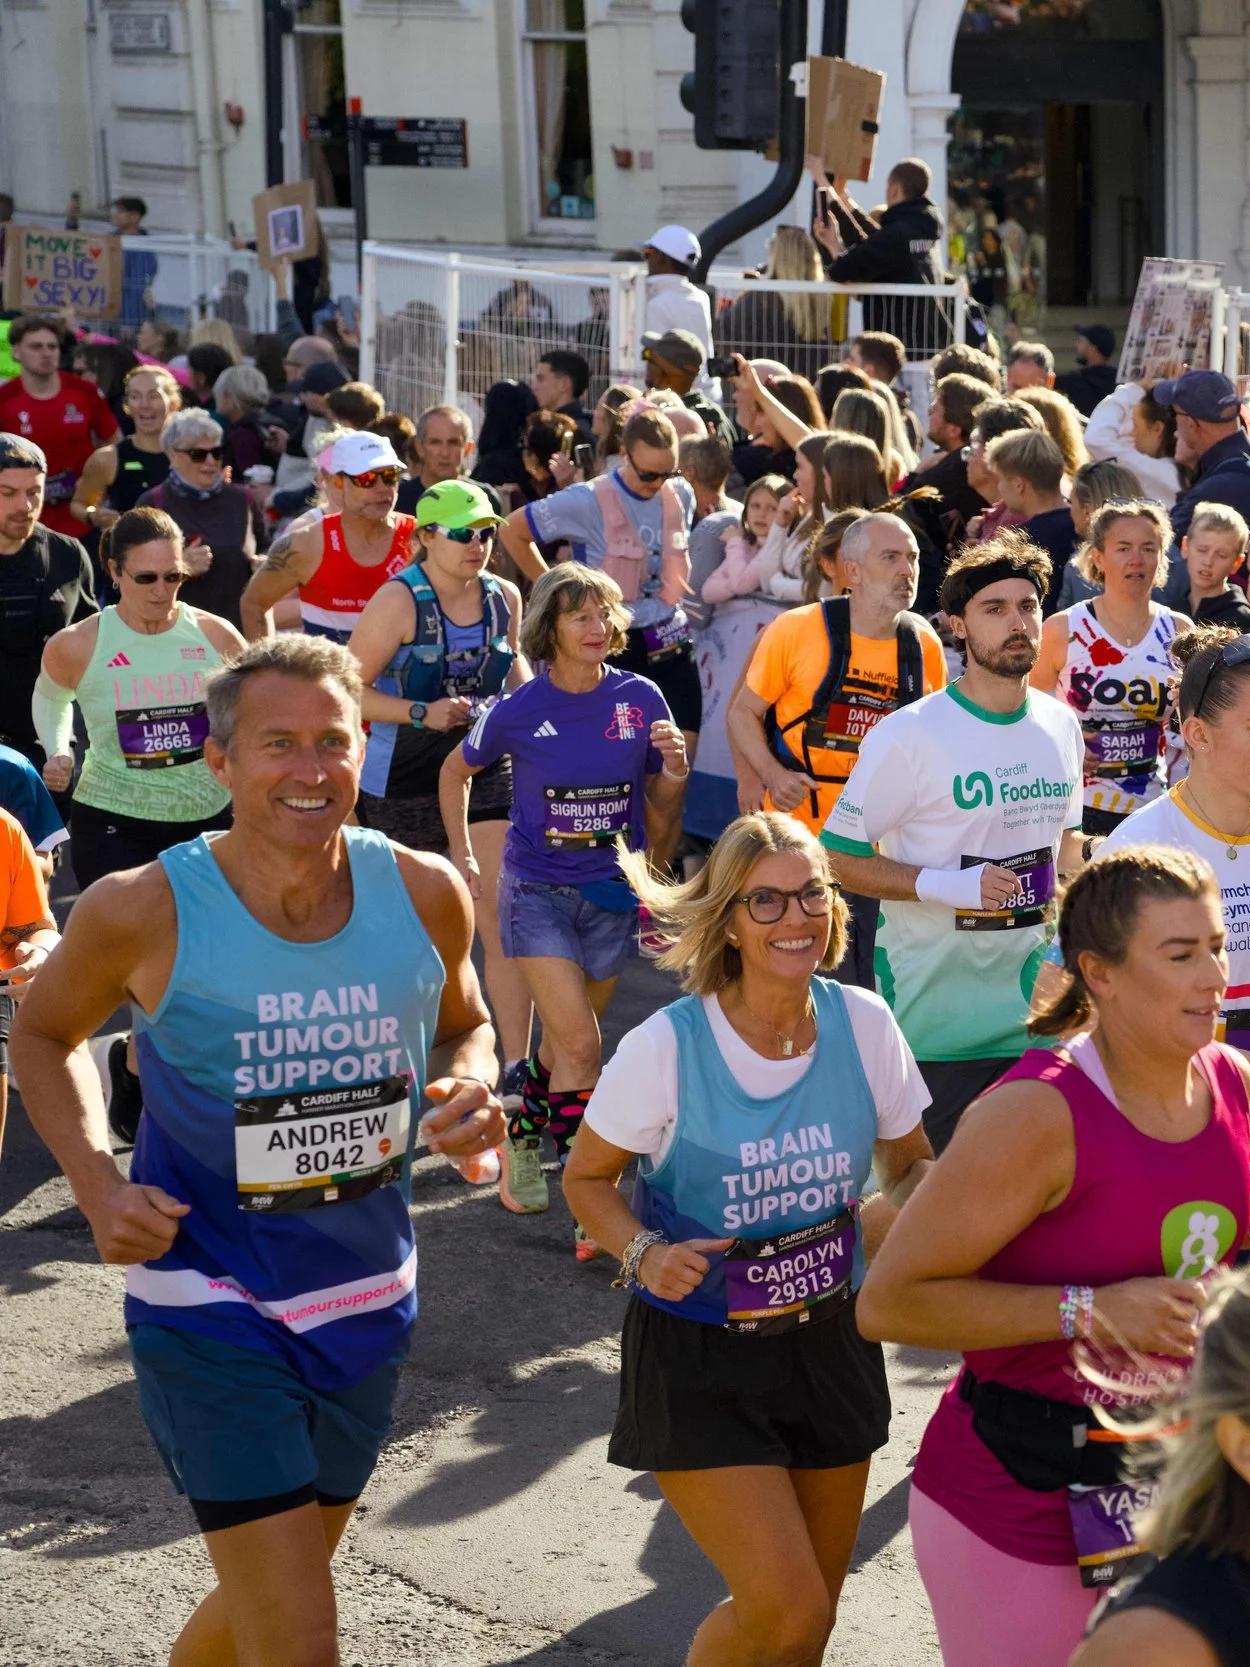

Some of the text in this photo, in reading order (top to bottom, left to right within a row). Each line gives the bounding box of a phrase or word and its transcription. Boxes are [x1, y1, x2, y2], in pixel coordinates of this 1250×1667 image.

[25, 232, 86, 257] MOVE
[26, 253, 97, 282] IT BIG
[34, 279, 106, 312] SEXY!
[332, 598, 356, 607] North
[113, 672, 207, 711] LINDA
[1070, 672, 1173, 717] soap
[150, 708, 176, 717] CARDIFF
[143, 722, 190, 738] LINDA
[145, 734, 192, 752] 26665
[1101, 733, 1146, 748] SARAH
[1103, 747, 1144, 761] 22694
[996, 763, 1028, 778] Cardiff
[578, 786, 620, 796] CARDIFF HALF
[550, 799, 629, 817] SIGRUN ROMY
[1004, 808, 1018, 817] Banc
[1020, 803, 1039, 814] Bwyd
[574, 817, 611, 832] 5286
[1003, 818, 1030, 830] Together
[1000, 857, 1023, 868] CARDIFF
[1023, 852, 1037, 863] HALF
[257, 983, 379, 1024] BRAIN
[233, 1016, 400, 1060] TUMOUR
[233, 1047, 402, 1095] SUPPORT
[300, 1086, 381, 1107] CARDIFF HALF
[266, 1112, 388, 1151] ANDREW
[740, 1123, 833, 1168] BRAIN
[295, 1144, 364, 1175] 8042
[722, 1151, 852, 1199] TUMOUR
[723, 1180, 854, 1230] SUPPORT
[778, 1219, 836, 1246] CARDIFF HALF
[747, 1237, 844, 1283] CAROLYN
[767, 1266, 834, 1305] 29313
